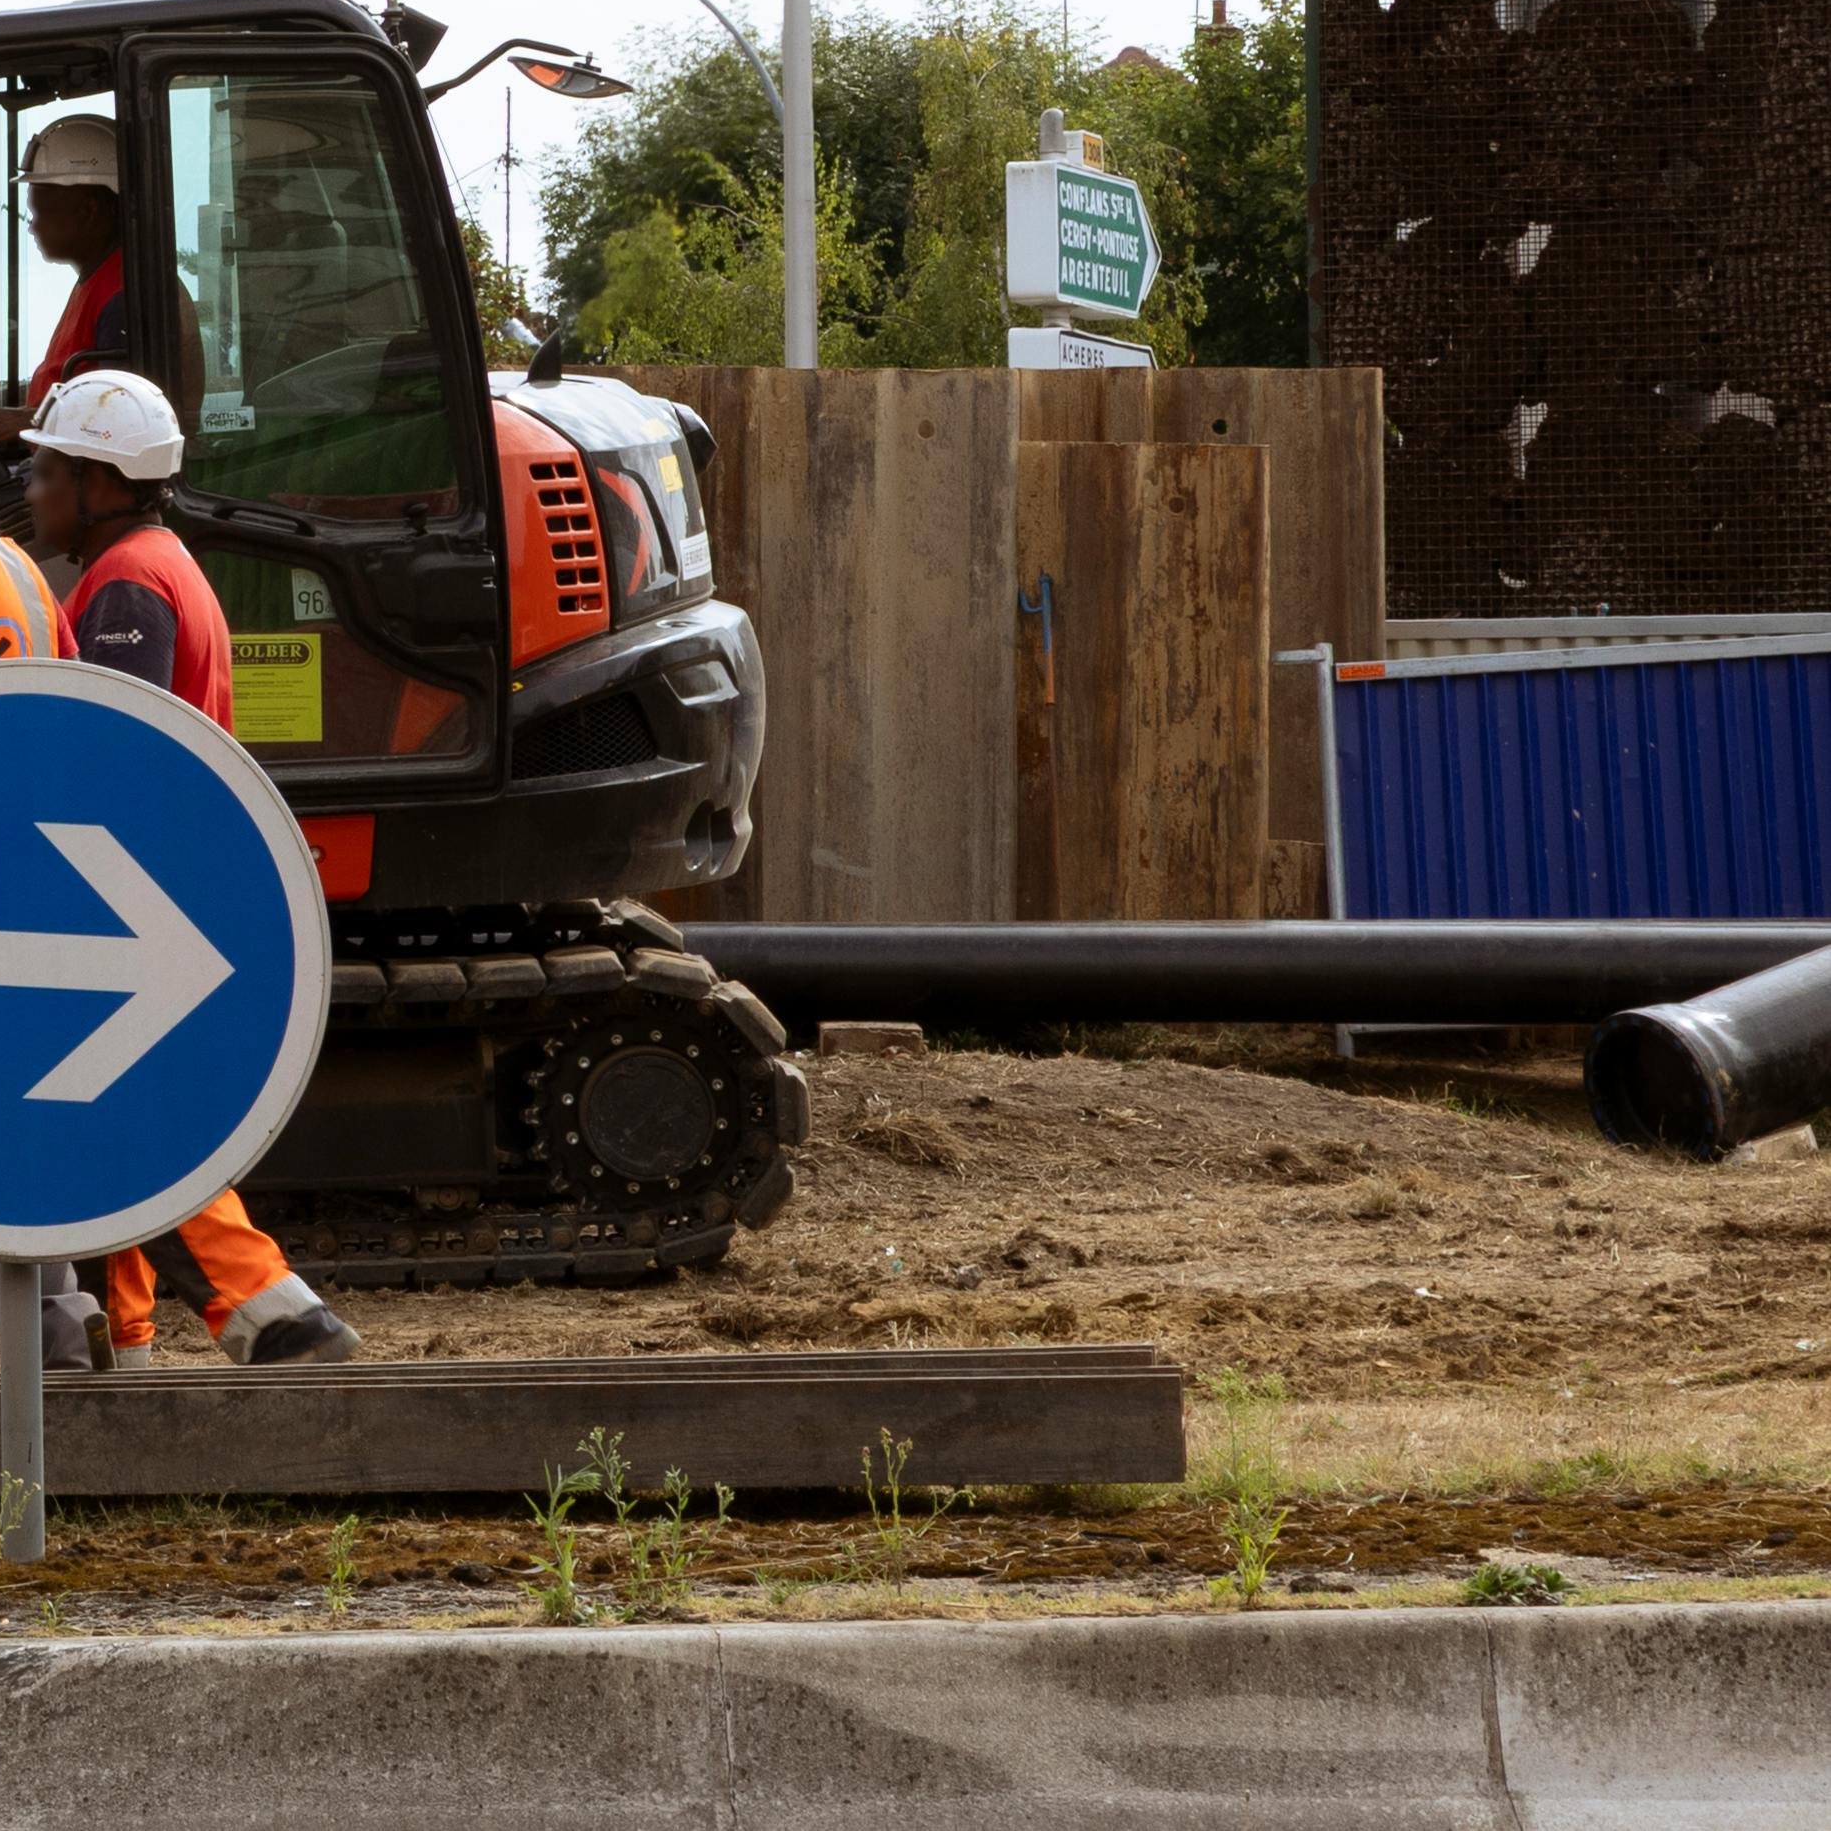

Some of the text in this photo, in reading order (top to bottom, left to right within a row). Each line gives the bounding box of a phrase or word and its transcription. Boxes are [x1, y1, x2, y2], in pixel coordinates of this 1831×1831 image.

[1059, 180, 1110, 219] CONFLANS
[1060, 217, 1140, 264] CERGY-PONTOISE
[1060, 255, 1131, 298] ARGENTEUIL
[1062, 342, 1105, 368] ACHERES
[298, 590, 324, 615] 96
